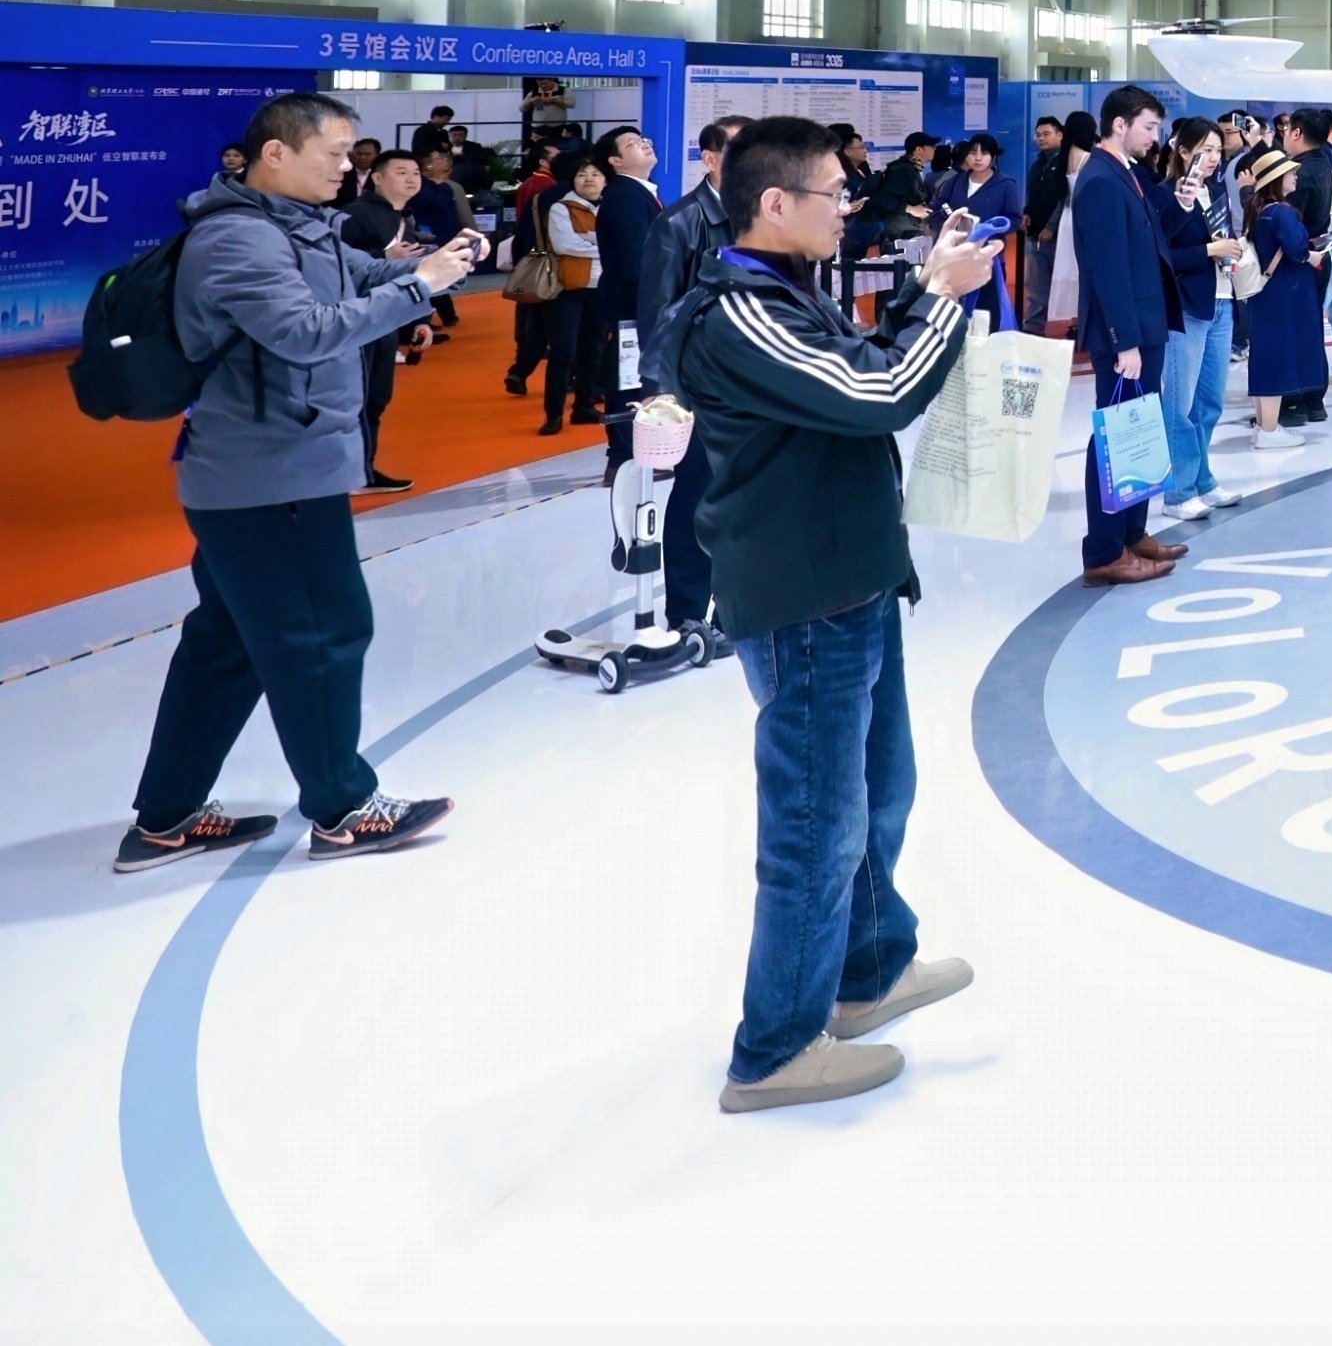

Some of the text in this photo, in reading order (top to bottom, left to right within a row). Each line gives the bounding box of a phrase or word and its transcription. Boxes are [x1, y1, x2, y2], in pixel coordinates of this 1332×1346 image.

[319, 32, 647, 69] 3号馆会议区 Conference Area, Hall 3
[18, 109, 117, 146] 智联湾区
[45, 154, 55, 164] IN
